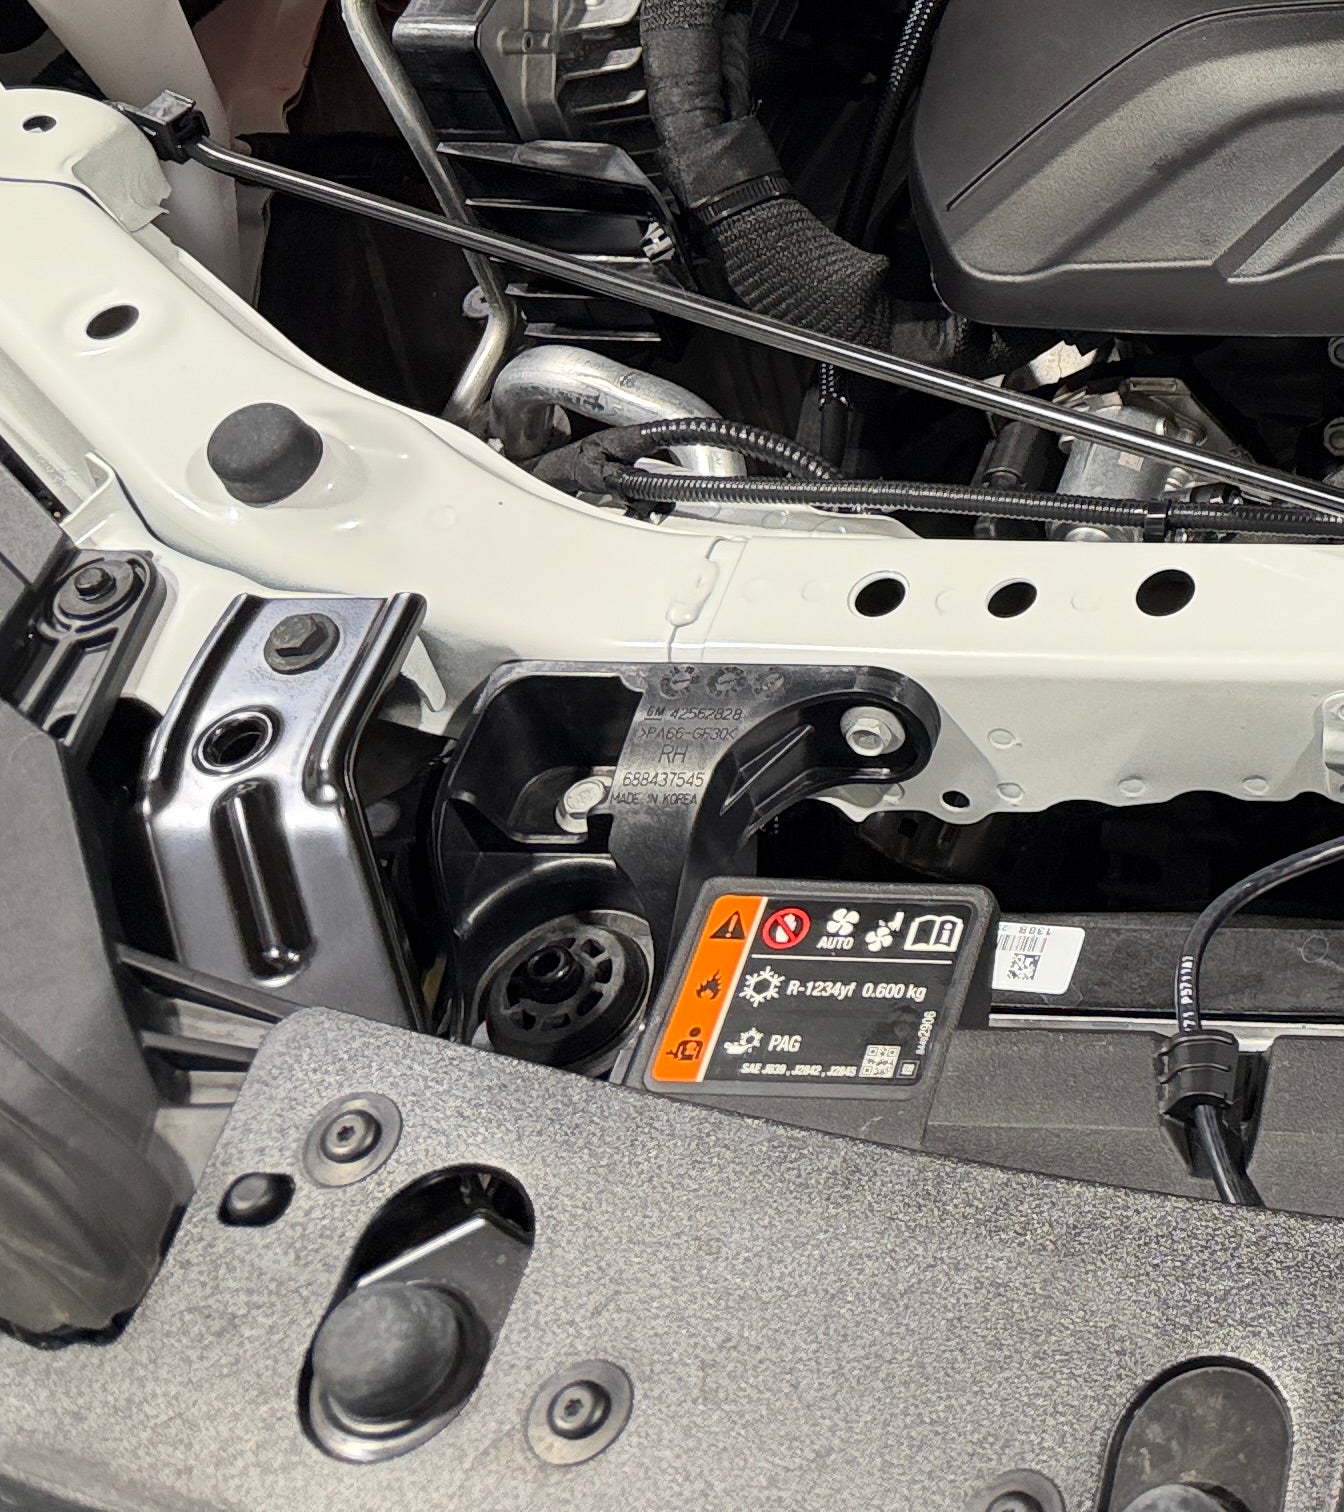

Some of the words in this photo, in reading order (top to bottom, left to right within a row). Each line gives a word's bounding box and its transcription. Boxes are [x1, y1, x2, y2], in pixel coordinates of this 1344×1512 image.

[658, 743, 689, 764] RH
[622, 771, 705, 788] 688437545
[610, 792, 639, 805] MADE
[648, 793, 659, 805] IN
[663, 793, 698, 805] KOREA
[816, 936, 855, 950] AUTO
[787, 979, 857, 1001] R-1234yf
[861, 982, 904, 998] 0.600
[905, 984, 928, 1003] kg
[767, 1035, 802, 1053] PAG
[740, 1062, 763, 1075] SAE
